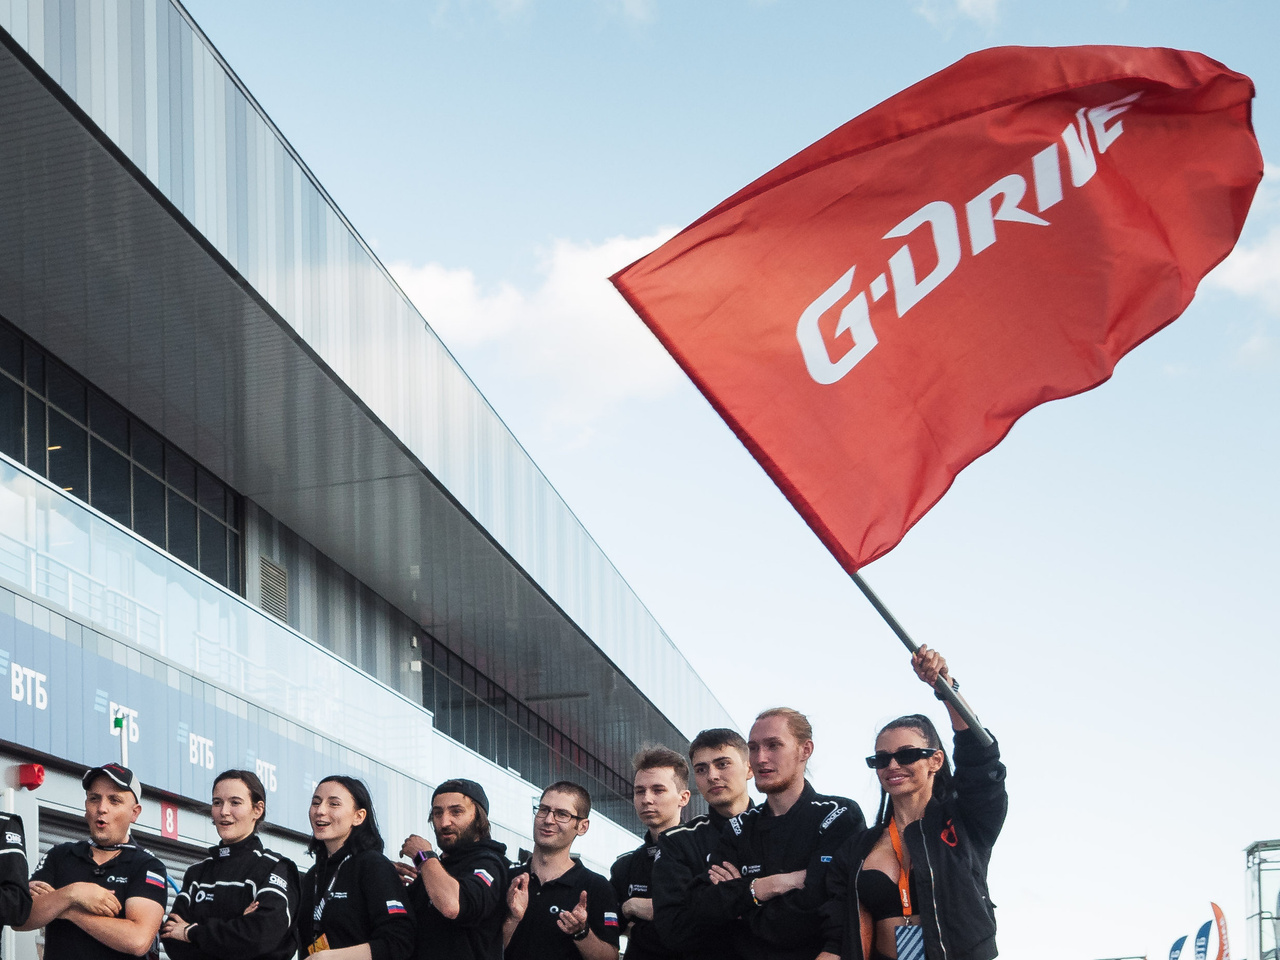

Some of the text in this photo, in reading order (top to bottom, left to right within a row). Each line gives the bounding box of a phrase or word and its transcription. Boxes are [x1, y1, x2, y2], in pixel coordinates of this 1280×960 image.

[10, 661, 48, 711] ВТБ
[189, 732, 215, 770] ВТБ
[166, 807, 174, 833] 8
